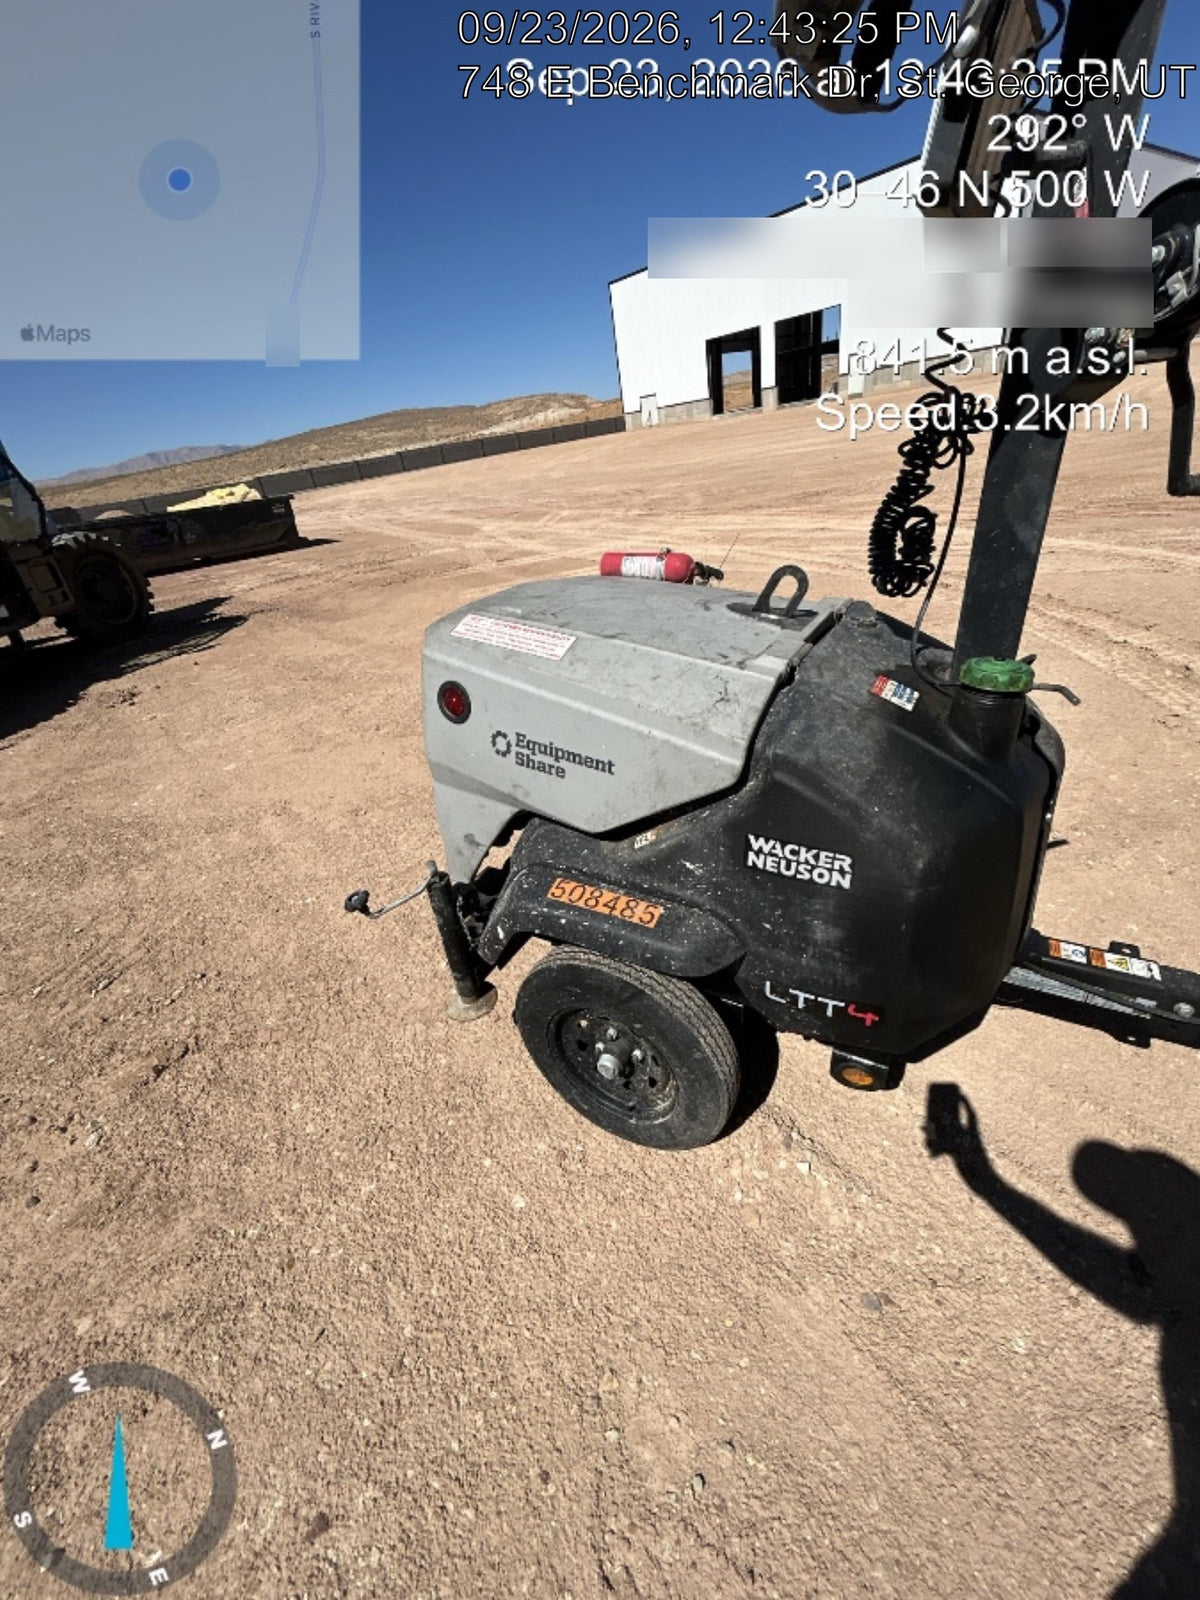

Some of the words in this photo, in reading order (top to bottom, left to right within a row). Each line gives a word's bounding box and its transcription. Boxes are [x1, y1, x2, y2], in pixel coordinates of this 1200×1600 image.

[514, 731, 616, 776] Equipment
[514, 751, 566, 779] Share
[746, 850, 853, 890] NEUSON
[747, 833, 853, 874] WACKER
[550, 879, 659, 925] 508485
[764, 980, 879, 1027] LTT4
